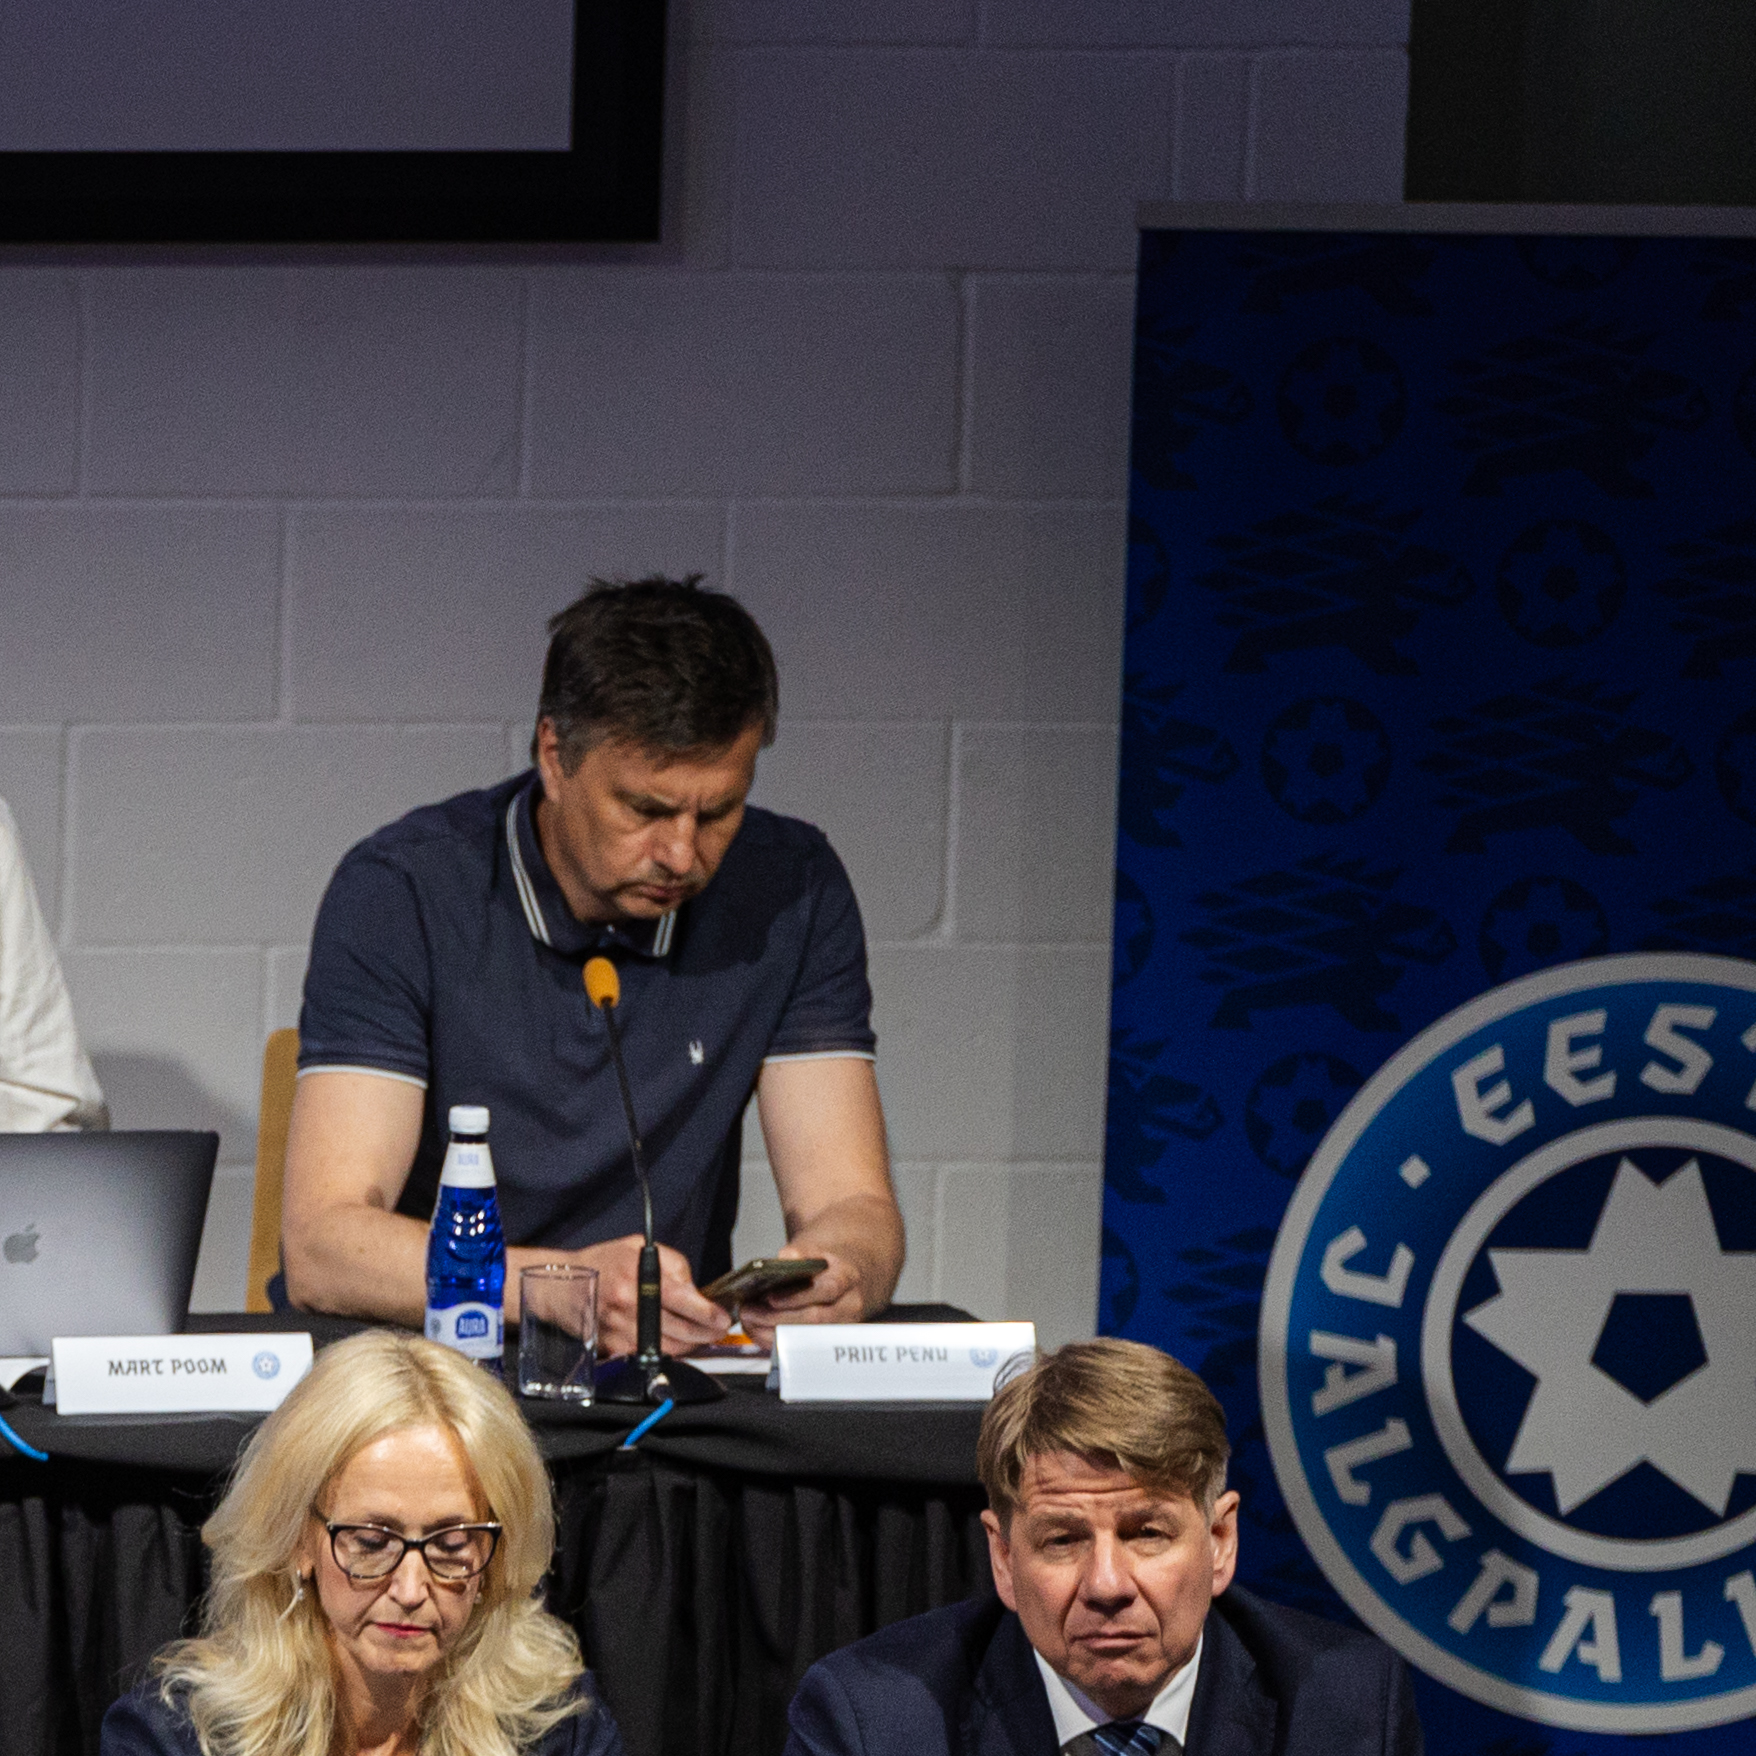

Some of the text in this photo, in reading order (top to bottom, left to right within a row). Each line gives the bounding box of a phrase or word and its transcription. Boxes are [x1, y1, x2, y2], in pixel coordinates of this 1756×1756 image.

[1452, 1002, 1756, 1146] EES
[458, 1318, 486, 1336] AURA
[833, 1345, 948, 1363] PRIIT PENU
[108, 1357, 227, 1376] MART POOM
